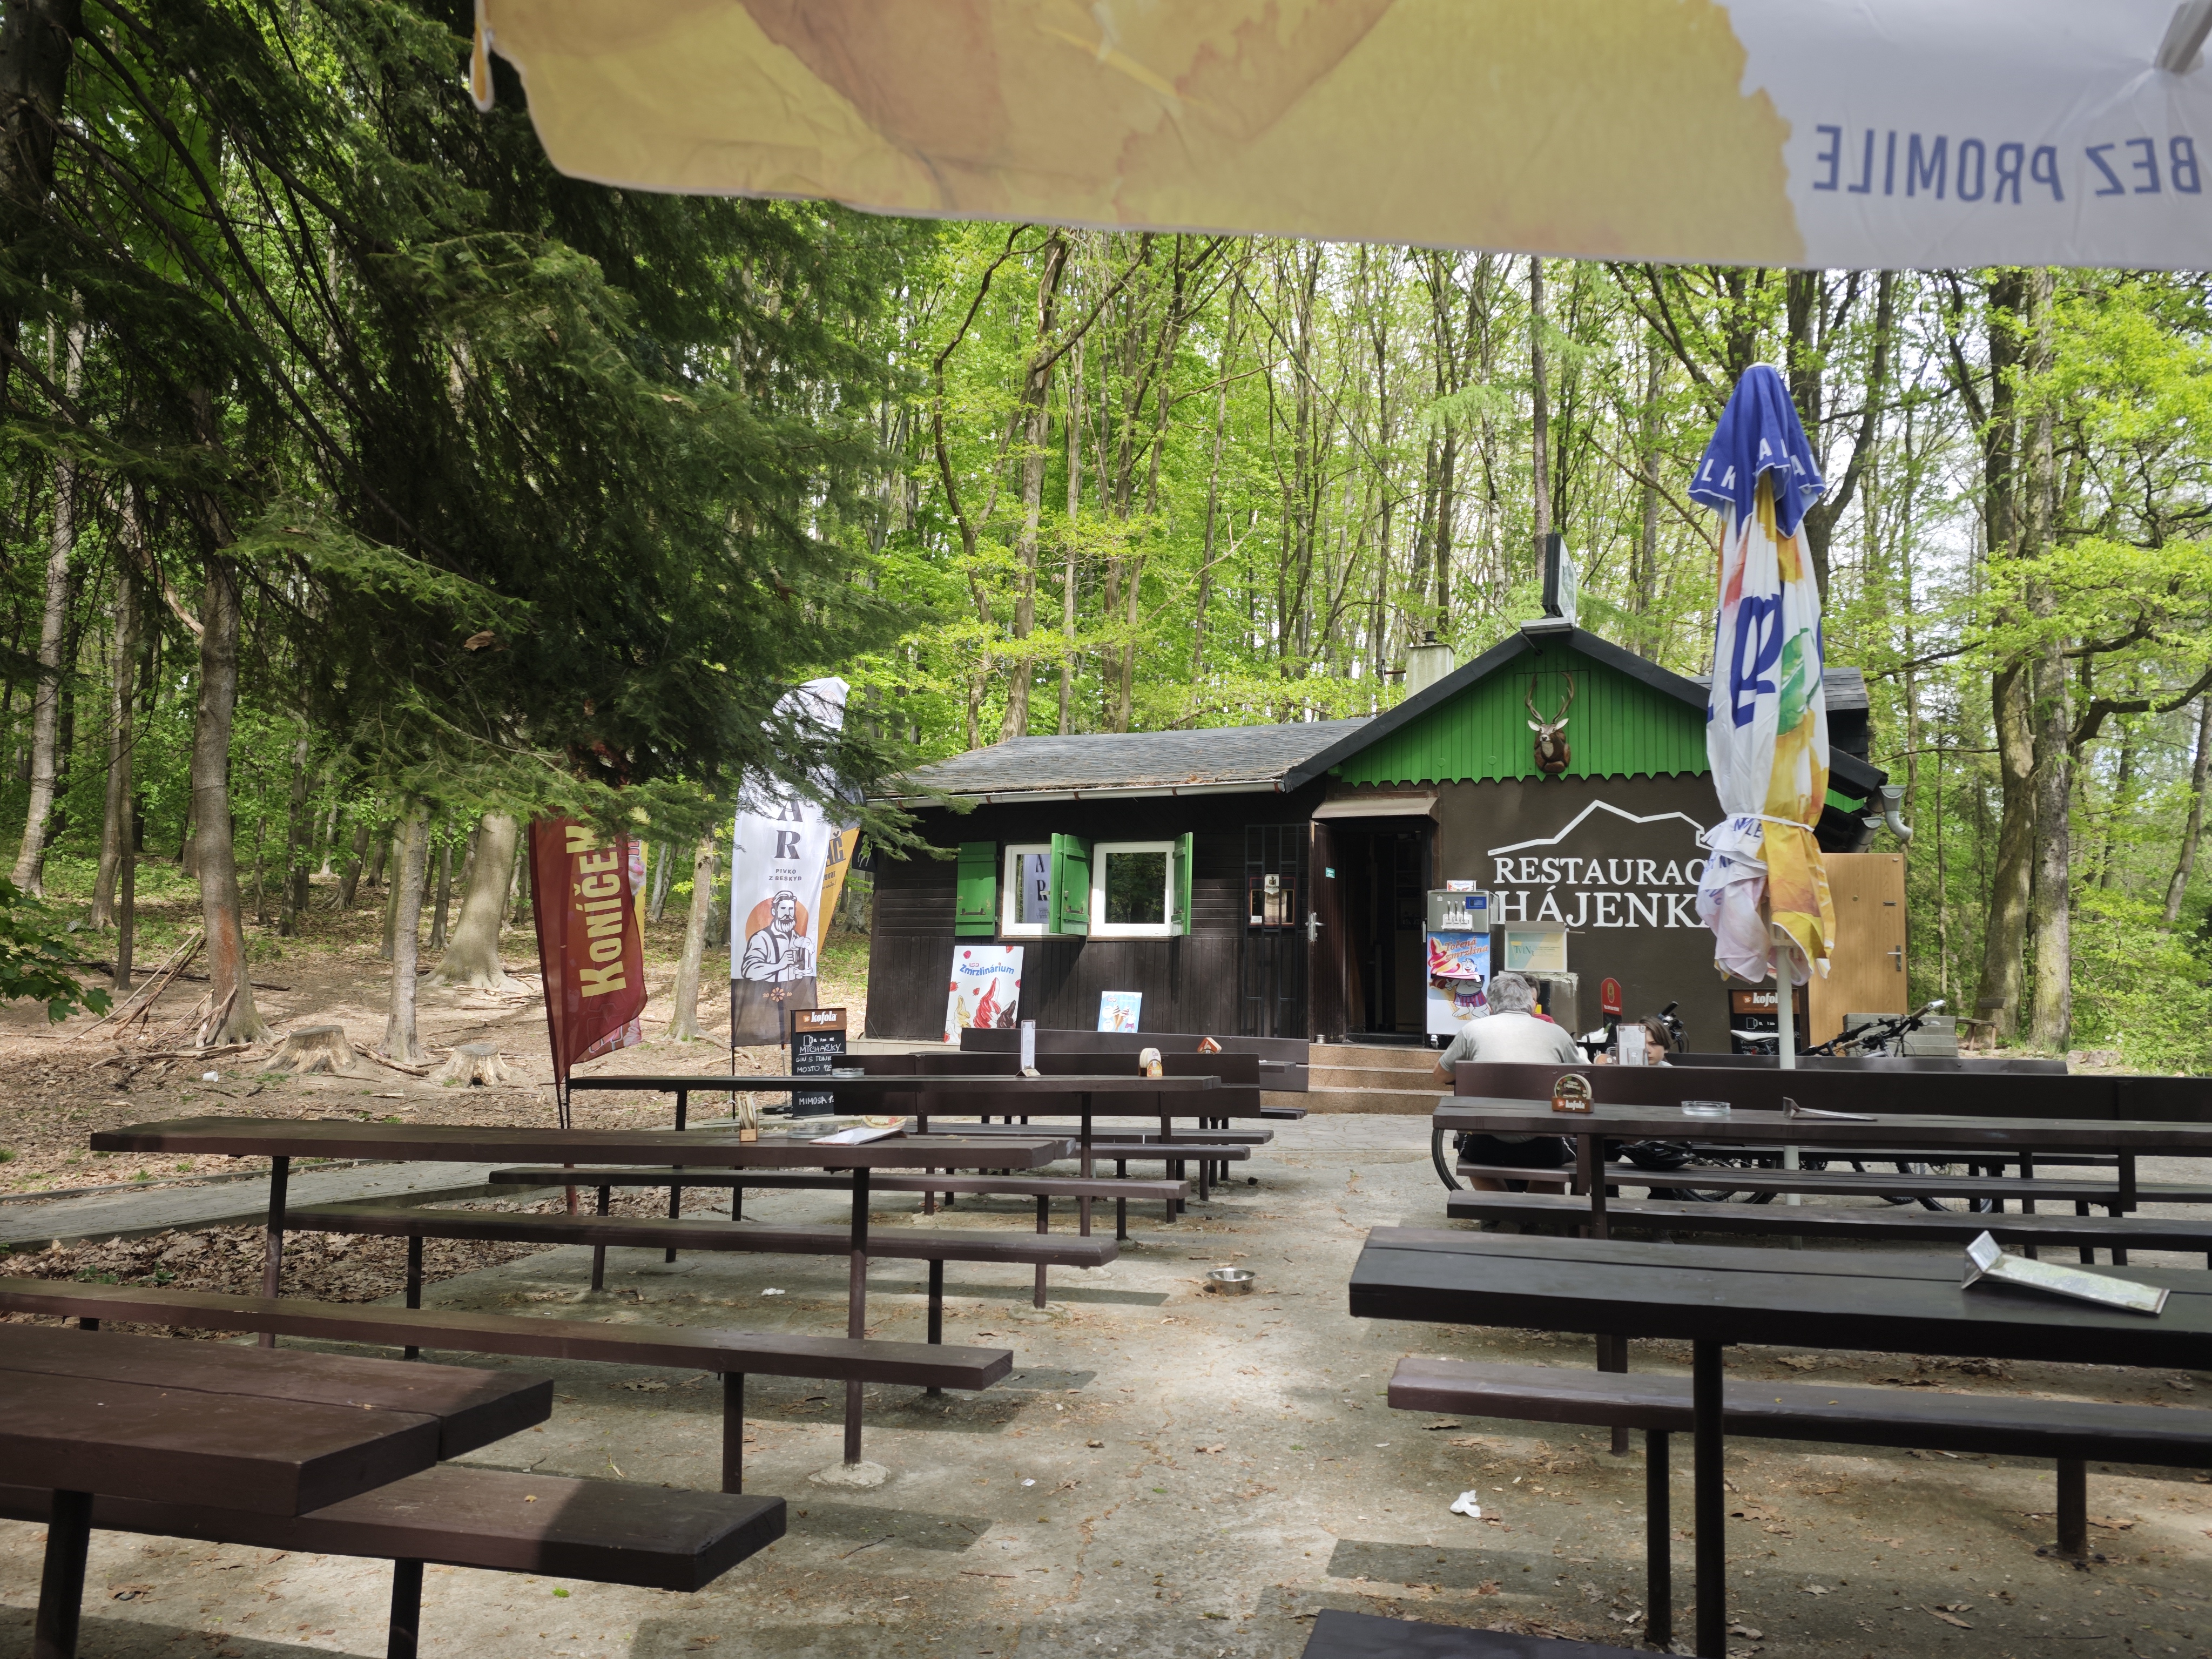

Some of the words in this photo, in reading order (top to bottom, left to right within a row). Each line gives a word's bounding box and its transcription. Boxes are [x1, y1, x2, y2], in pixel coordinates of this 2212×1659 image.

[1494, 858, 1708, 885] RESTAURAC
[565, 826, 626, 997] KONÍČEK
[1494, 885, 1710, 928] HÁJENK
[1445, 936, 1476, 951] Točená
[1446, 945, 1488, 960] zmrzlina
[960, 963, 1014, 976] Zmrzlinárium
[1752, 992, 1778, 1007] kofol
[811, 1011, 837, 1024] kofola
[799, 1096, 827, 1105] MIMOSA
